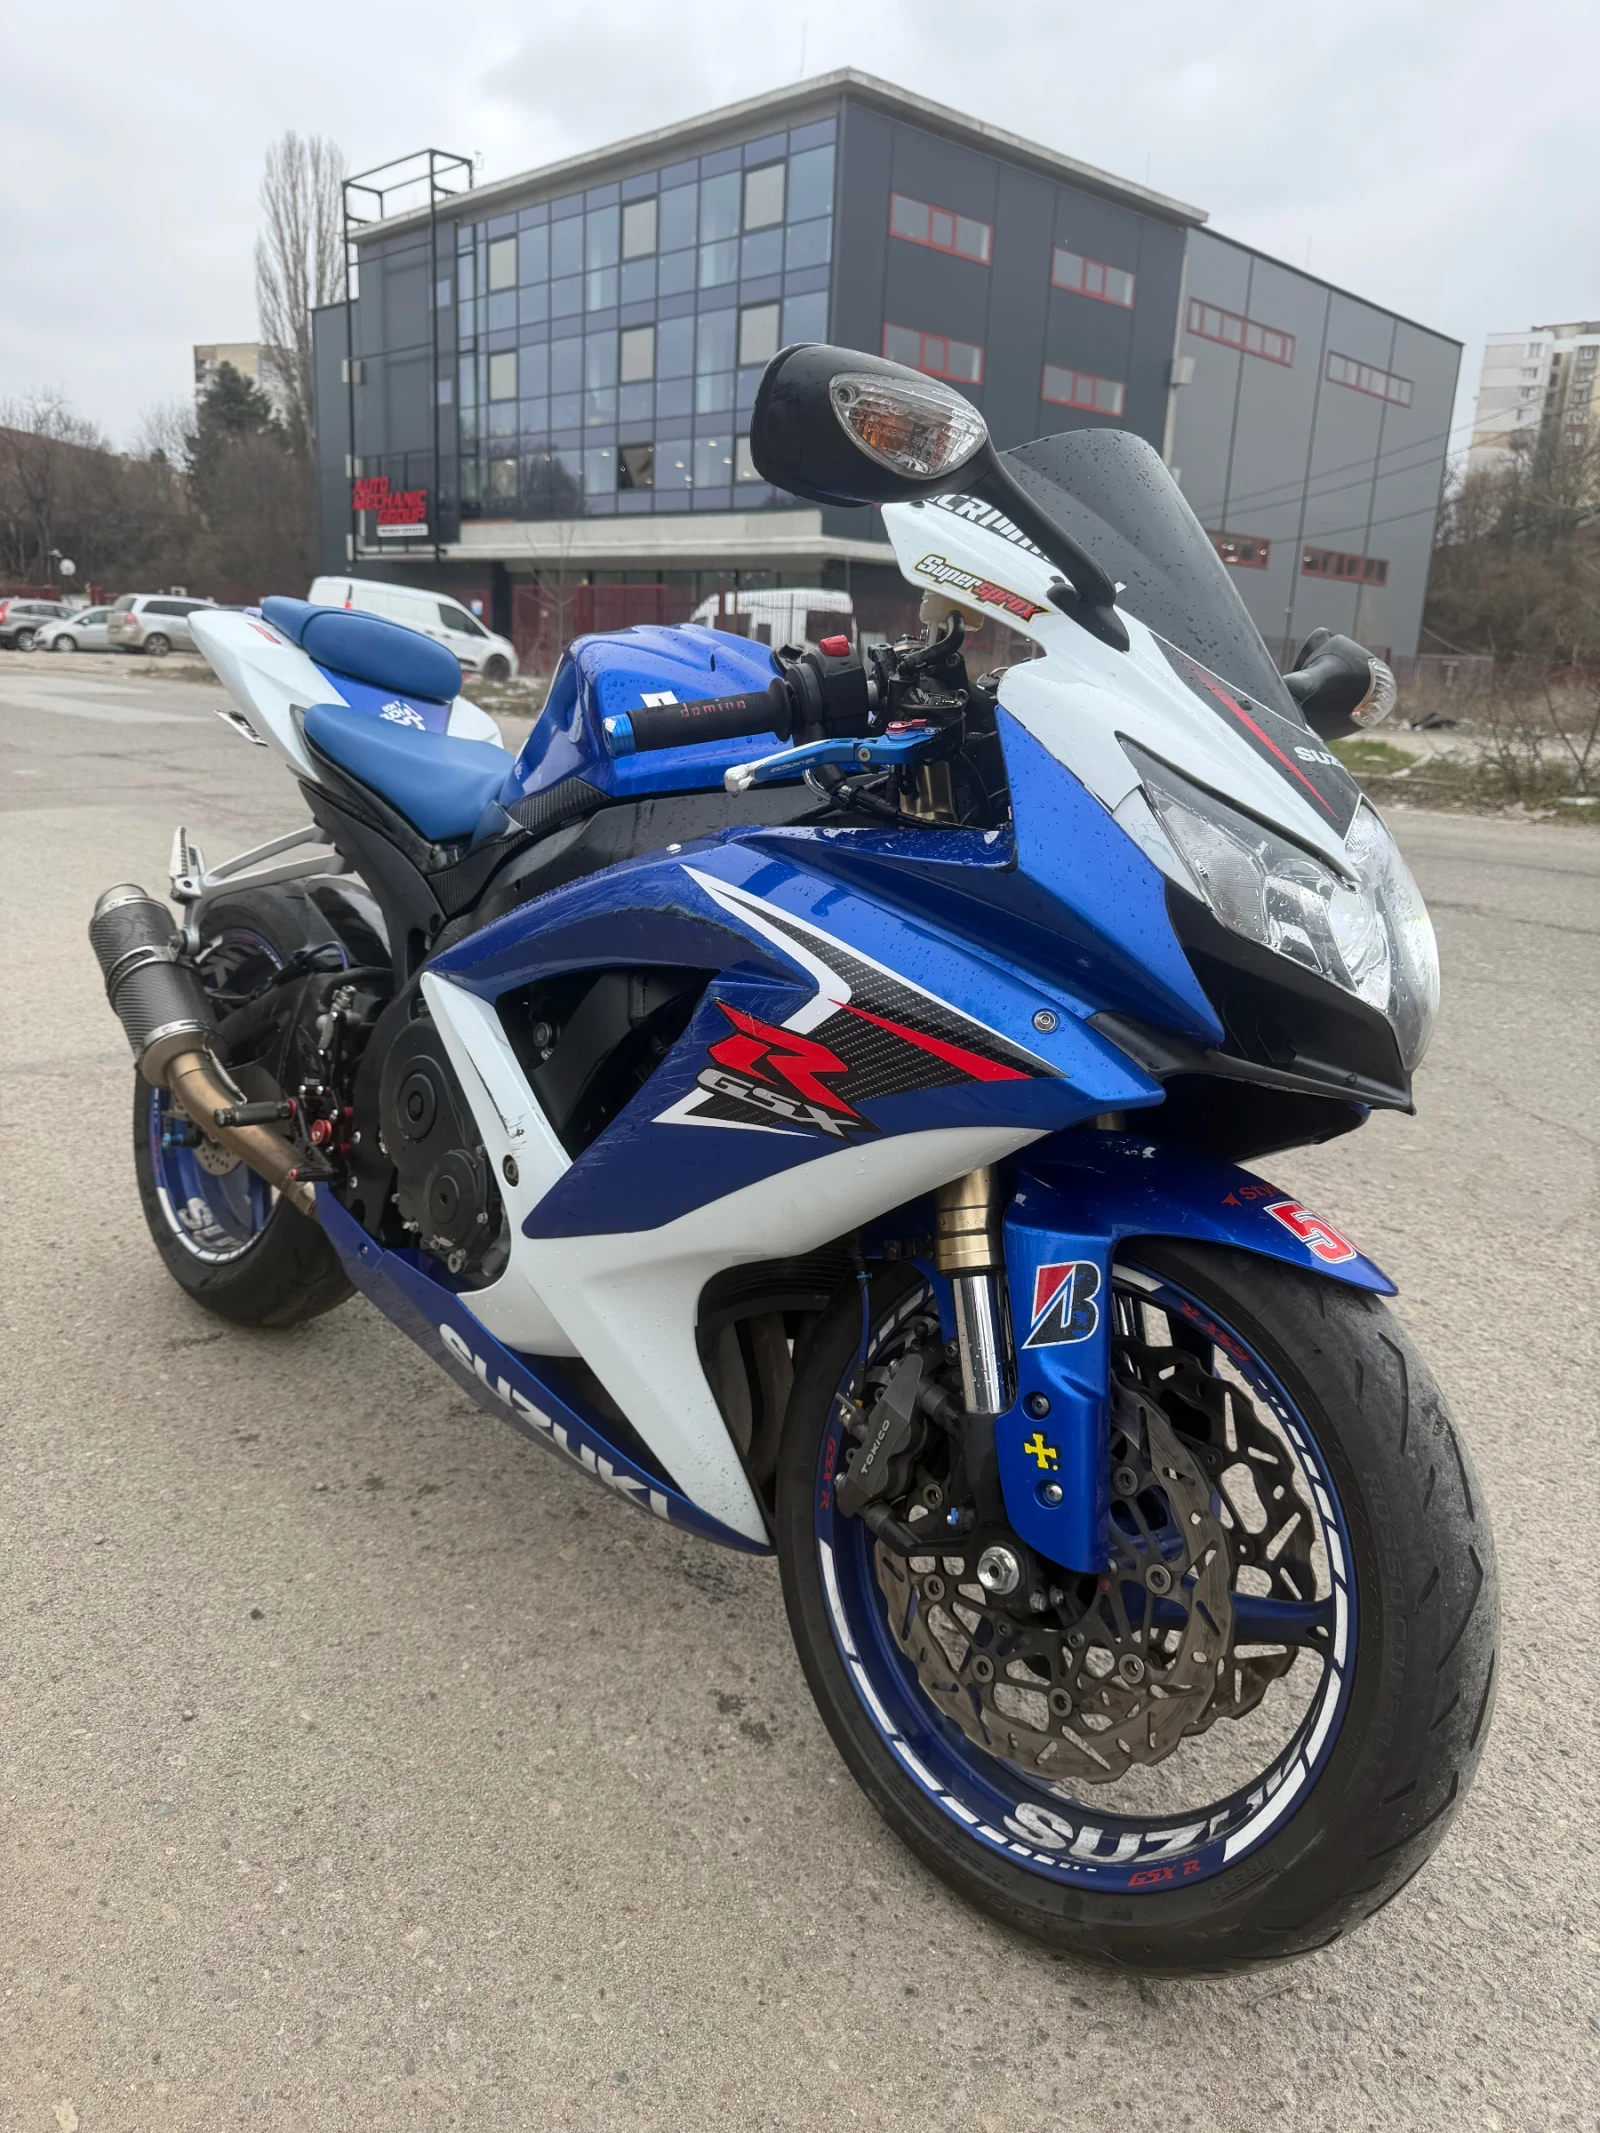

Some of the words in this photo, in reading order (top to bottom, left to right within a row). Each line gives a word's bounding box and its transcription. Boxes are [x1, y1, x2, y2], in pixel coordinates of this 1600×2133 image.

[353, 476, 389, 495] AUTO
[377, 507, 427, 525] GROUP
[698, 1068, 862, 1137] GSX
[439, 1323, 671, 1521] SUZUKI
[861, 1419, 890, 1474] TOKICO
[1127, 1864, 1177, 1887] GSX
[1183, 1859, 1202, 1876] R
